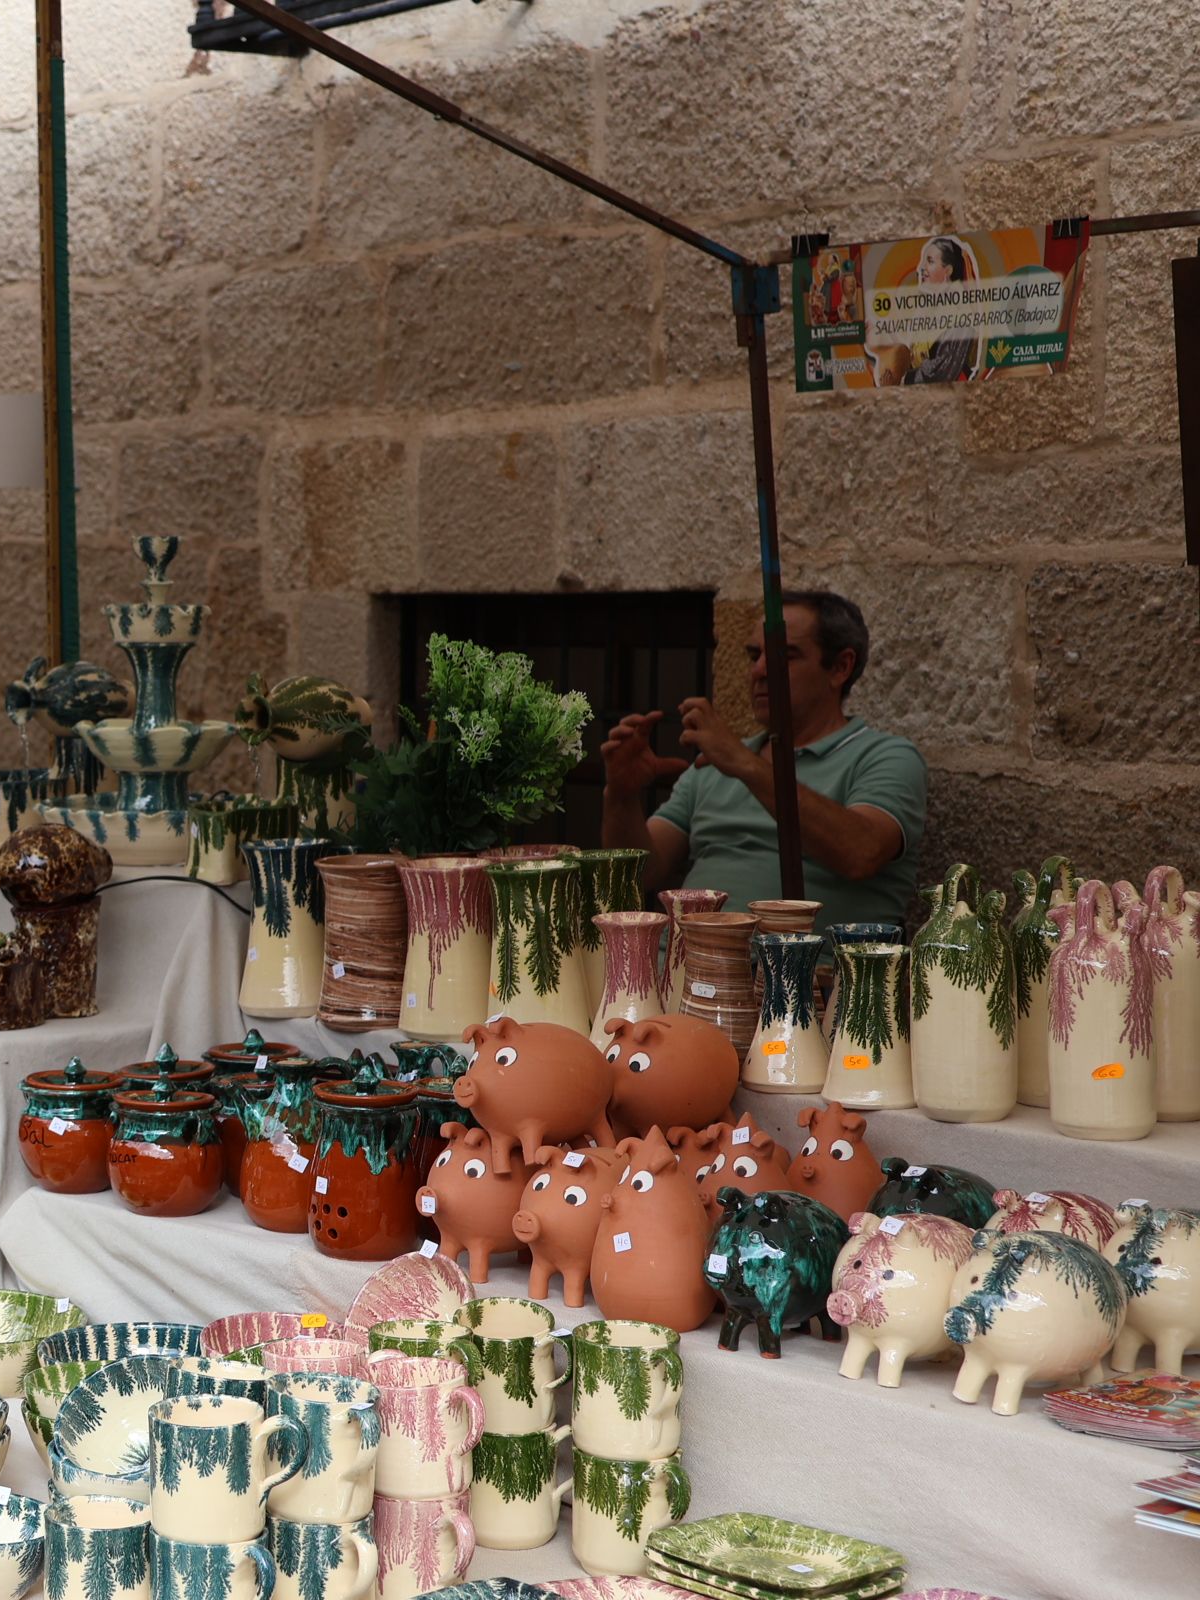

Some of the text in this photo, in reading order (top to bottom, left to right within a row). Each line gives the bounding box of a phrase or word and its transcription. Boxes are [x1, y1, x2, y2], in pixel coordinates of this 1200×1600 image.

[875, 281, 1061, 312] 30 VICTORIANO BERMEJO ÁLVAREZ
[875, 317, 937, 334] SALVATIERRA
[939, 315, 953, 329] DE
[954, 313, 972, 329] LOS
[973, 309, 1013, 327] BARROS
[1014, 304, 1059, 327] (Badajoz)
[1013, 342, 1064, 356] CAJA RURAL
